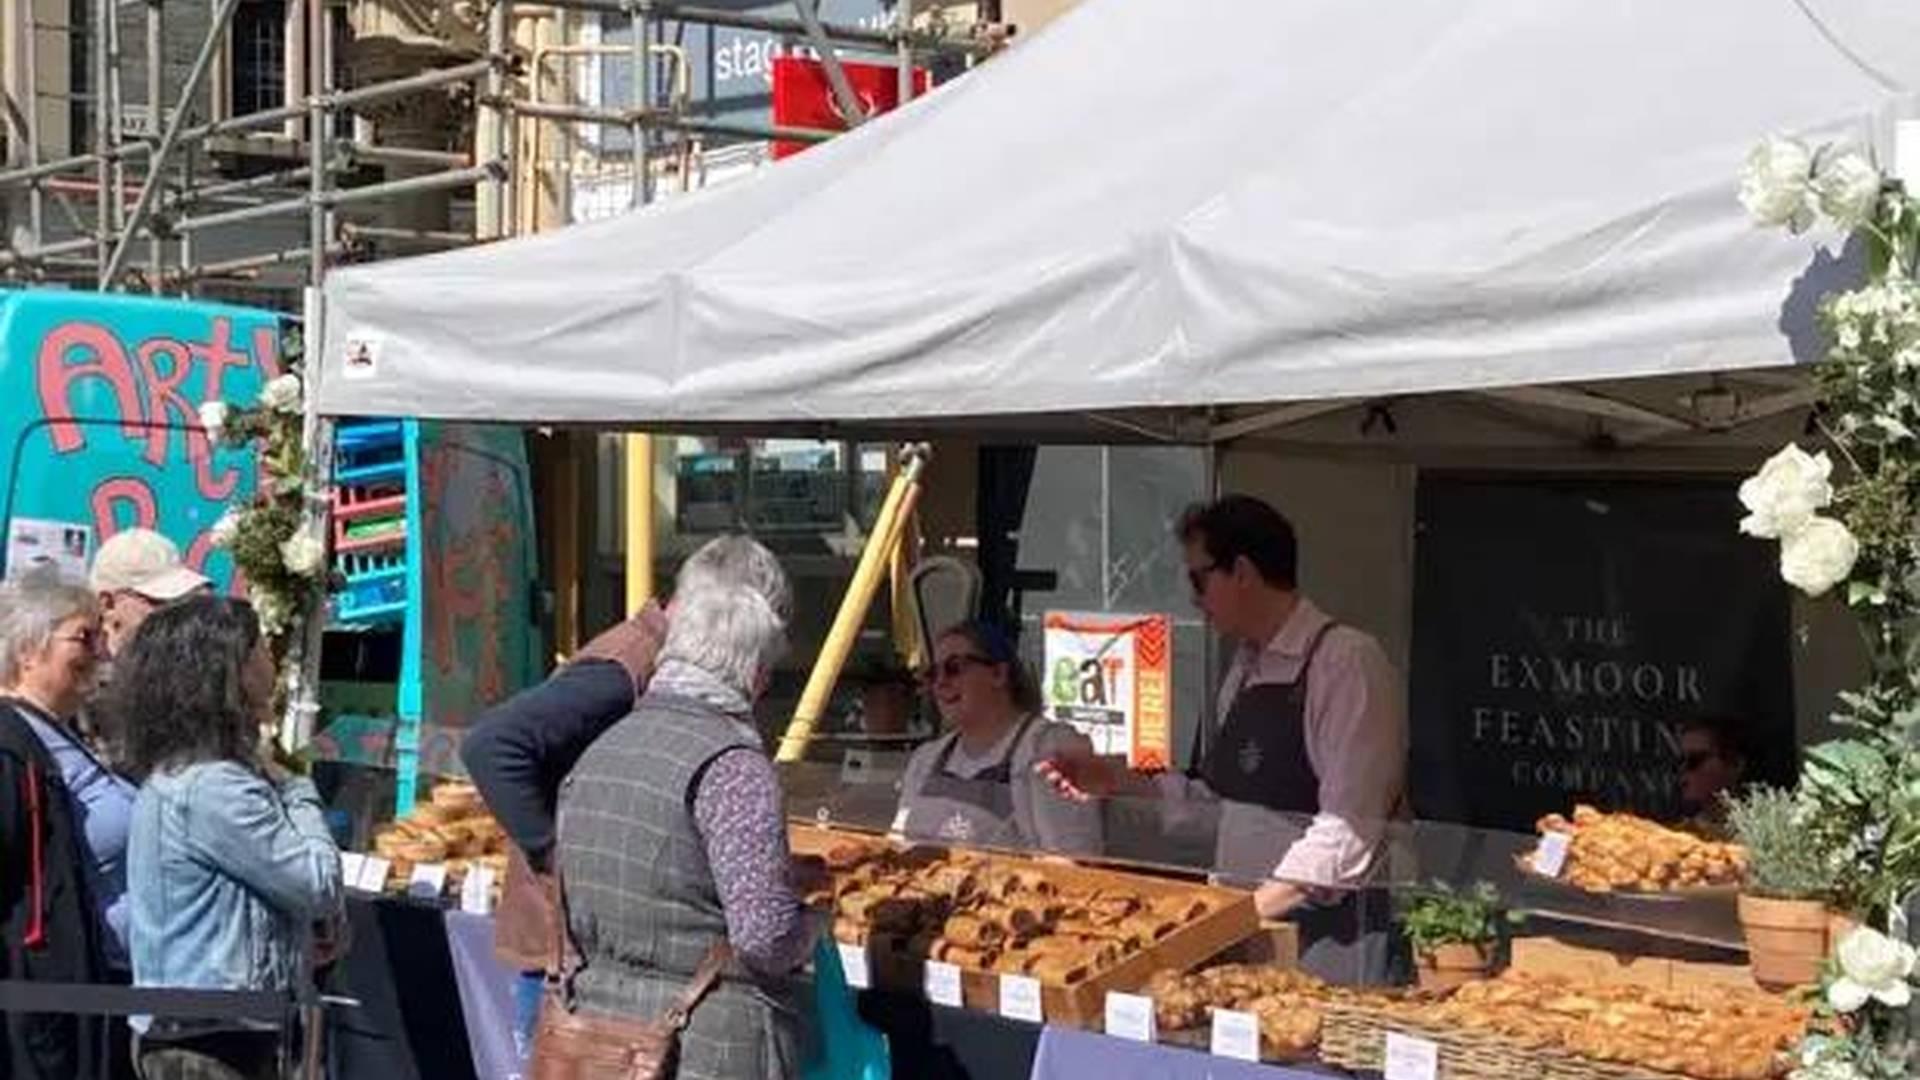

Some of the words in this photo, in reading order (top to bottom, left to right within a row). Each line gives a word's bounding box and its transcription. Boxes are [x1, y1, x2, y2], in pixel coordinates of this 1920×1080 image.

[1563, 615, 1629, 645] THE
[1488, 653, 1705, 702] EXMOOR
[1473, 707, 1687, 757] FEASTIN
